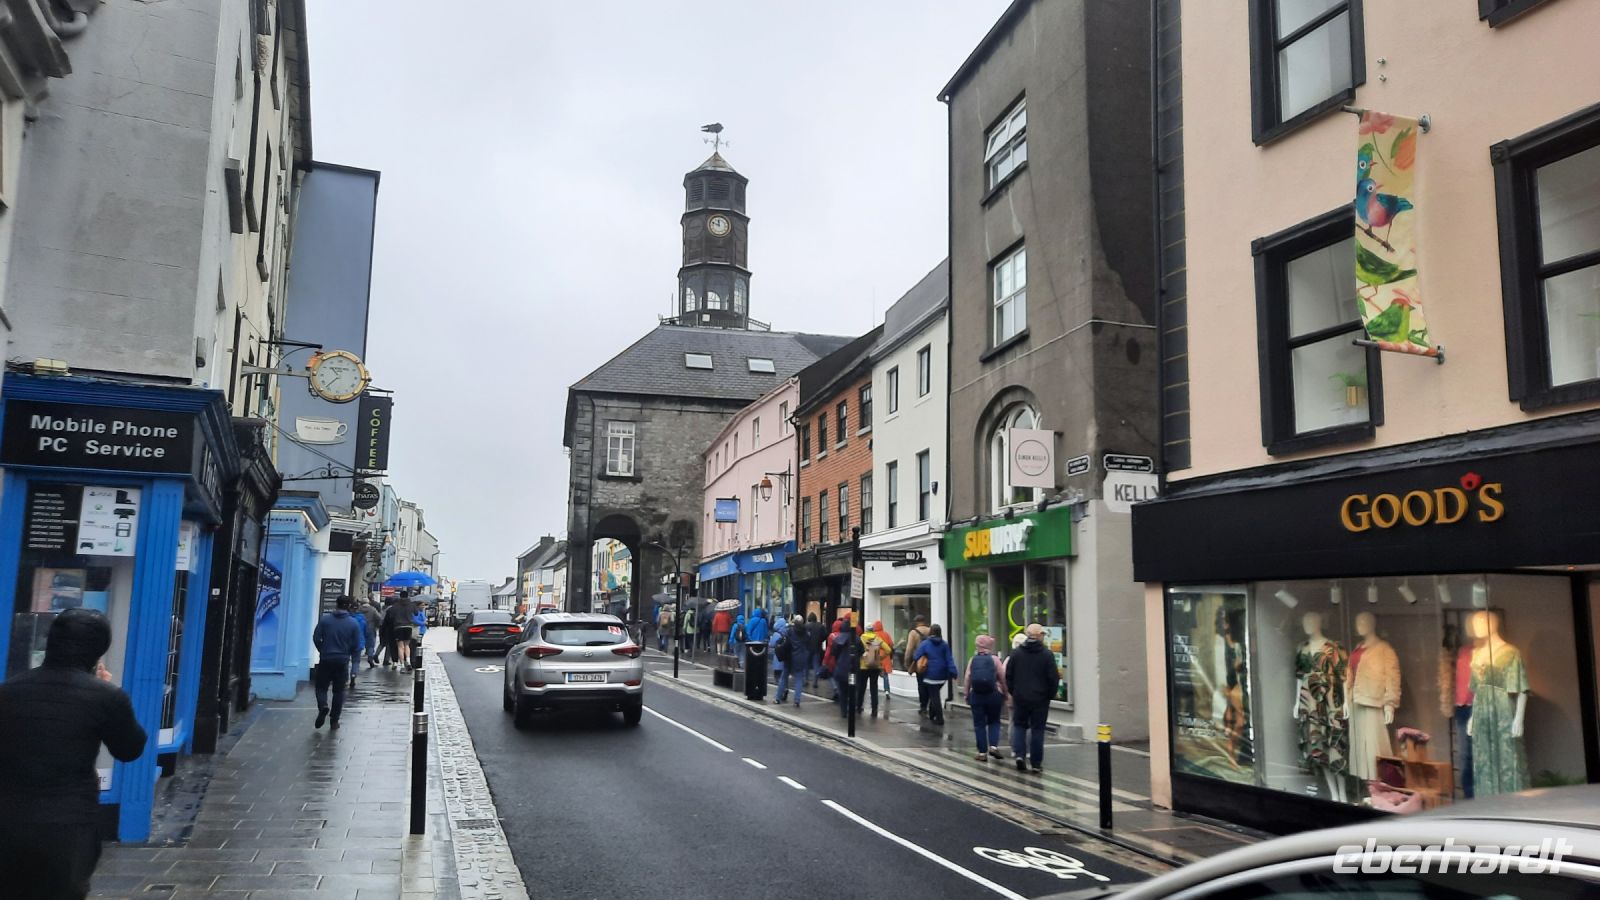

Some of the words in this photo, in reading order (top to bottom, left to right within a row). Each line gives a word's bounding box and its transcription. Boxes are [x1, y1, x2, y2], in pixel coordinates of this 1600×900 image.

[30, 414, 107, 434] Mobile
[111, 420, 178, 438] Phone
[368, 408, 381, 468] COFFEE
[39, 436, 68, 452] PC
[85, 439, 165, 458] Service
[963, 518, 1034, 560] SUBWAY
